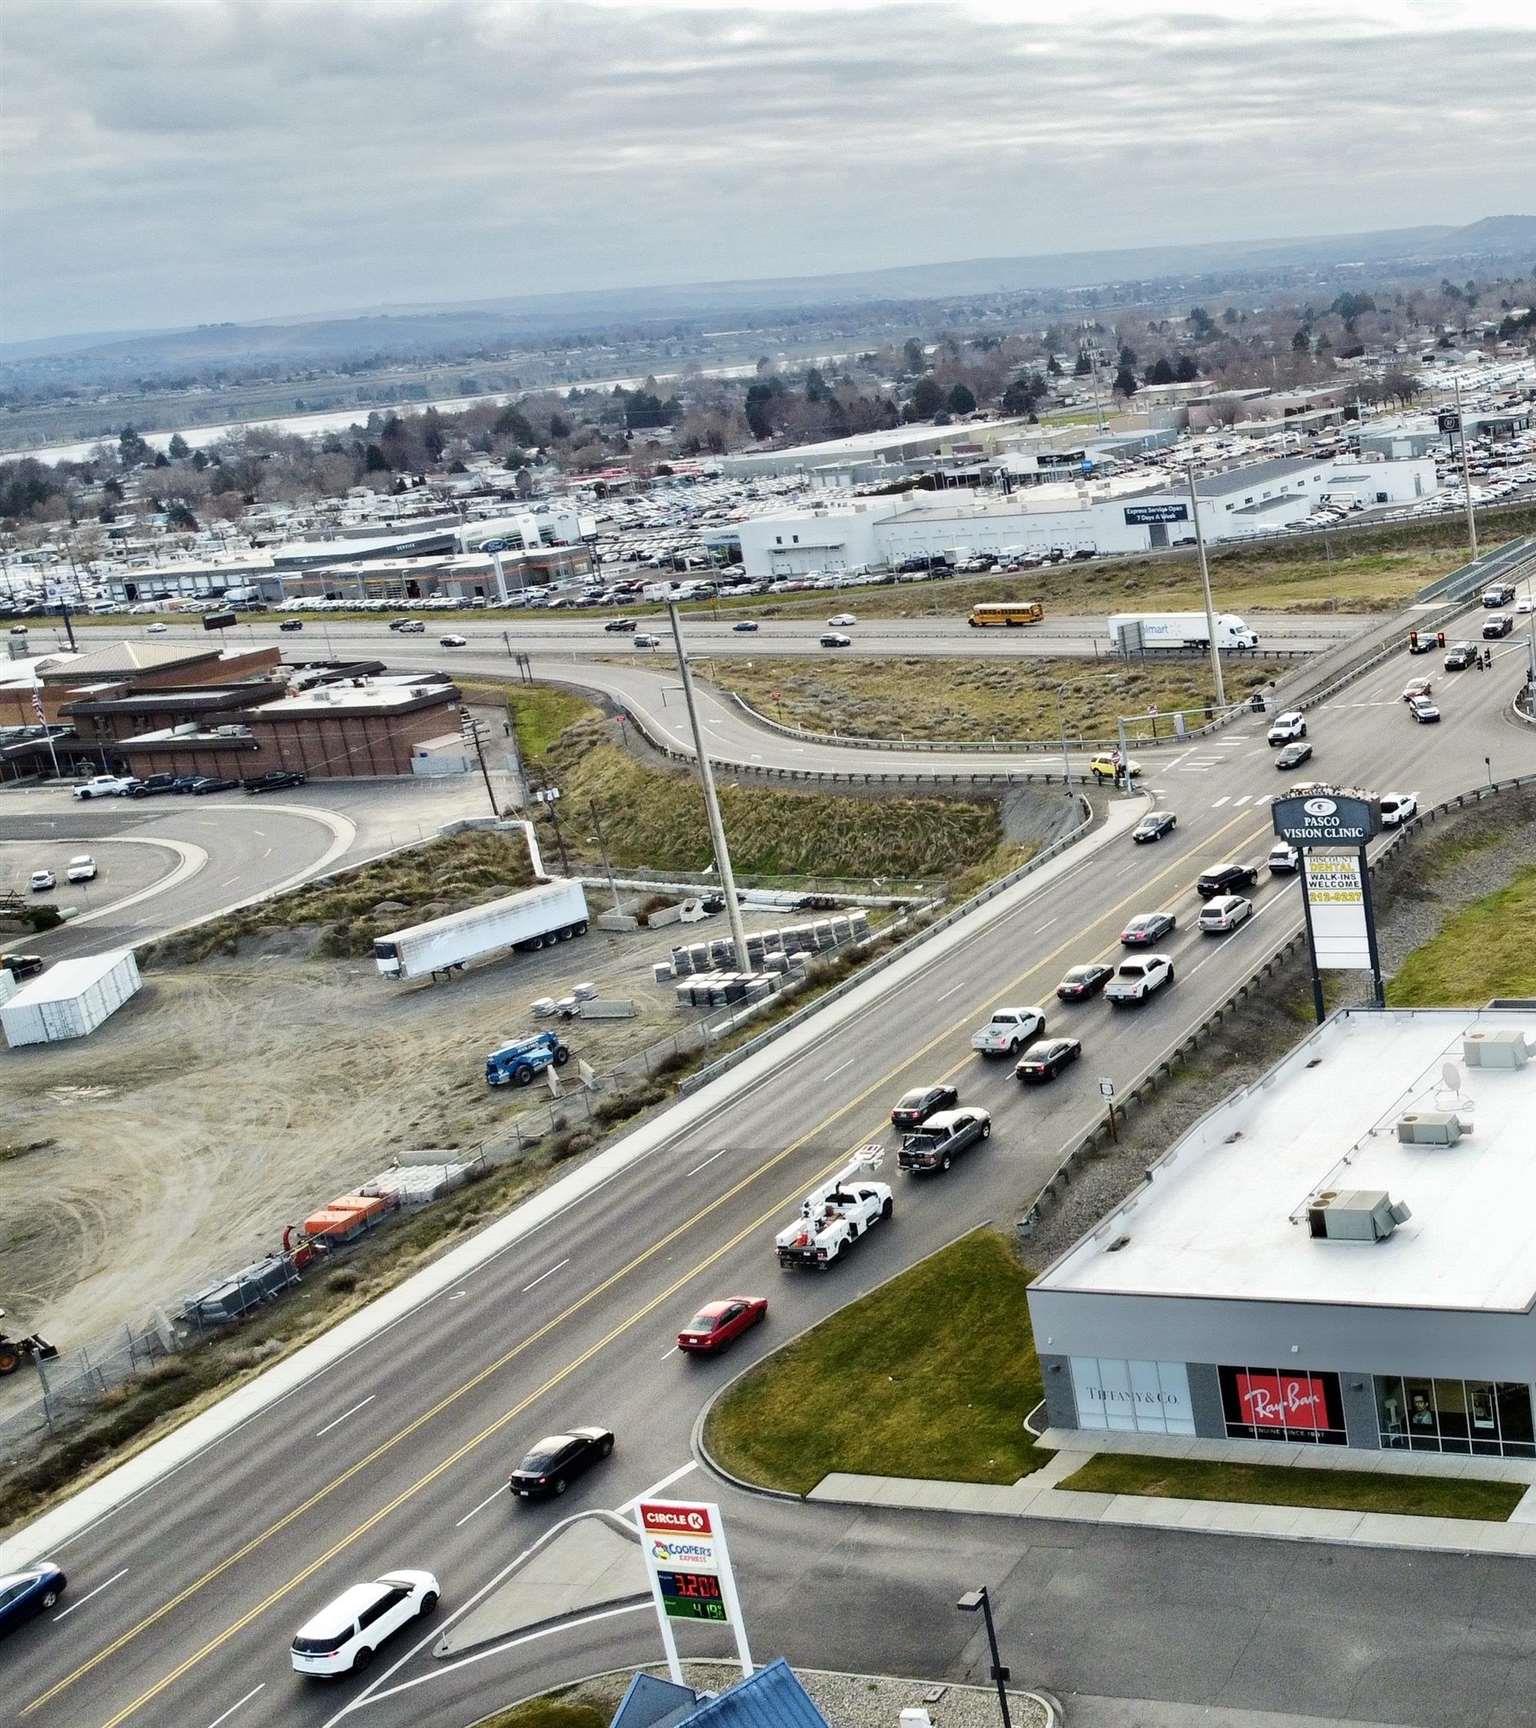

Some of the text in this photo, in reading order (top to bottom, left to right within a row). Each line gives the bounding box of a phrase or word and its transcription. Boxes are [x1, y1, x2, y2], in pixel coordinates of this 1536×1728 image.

[1304, 816, 1340, 826] PASCO
[1284, 827, 1364, 838] VISION CLINIC
[1311, 863, 1355, 872] DENTAL
[1311, 873, 1357, 881] WALK-INS
[1244, 1382, 1320, 1420] Ray-Ban
[646, 1512, 704, 1529] CIRCLE K
[669, 1543, 711, 1557] COOPER'S
